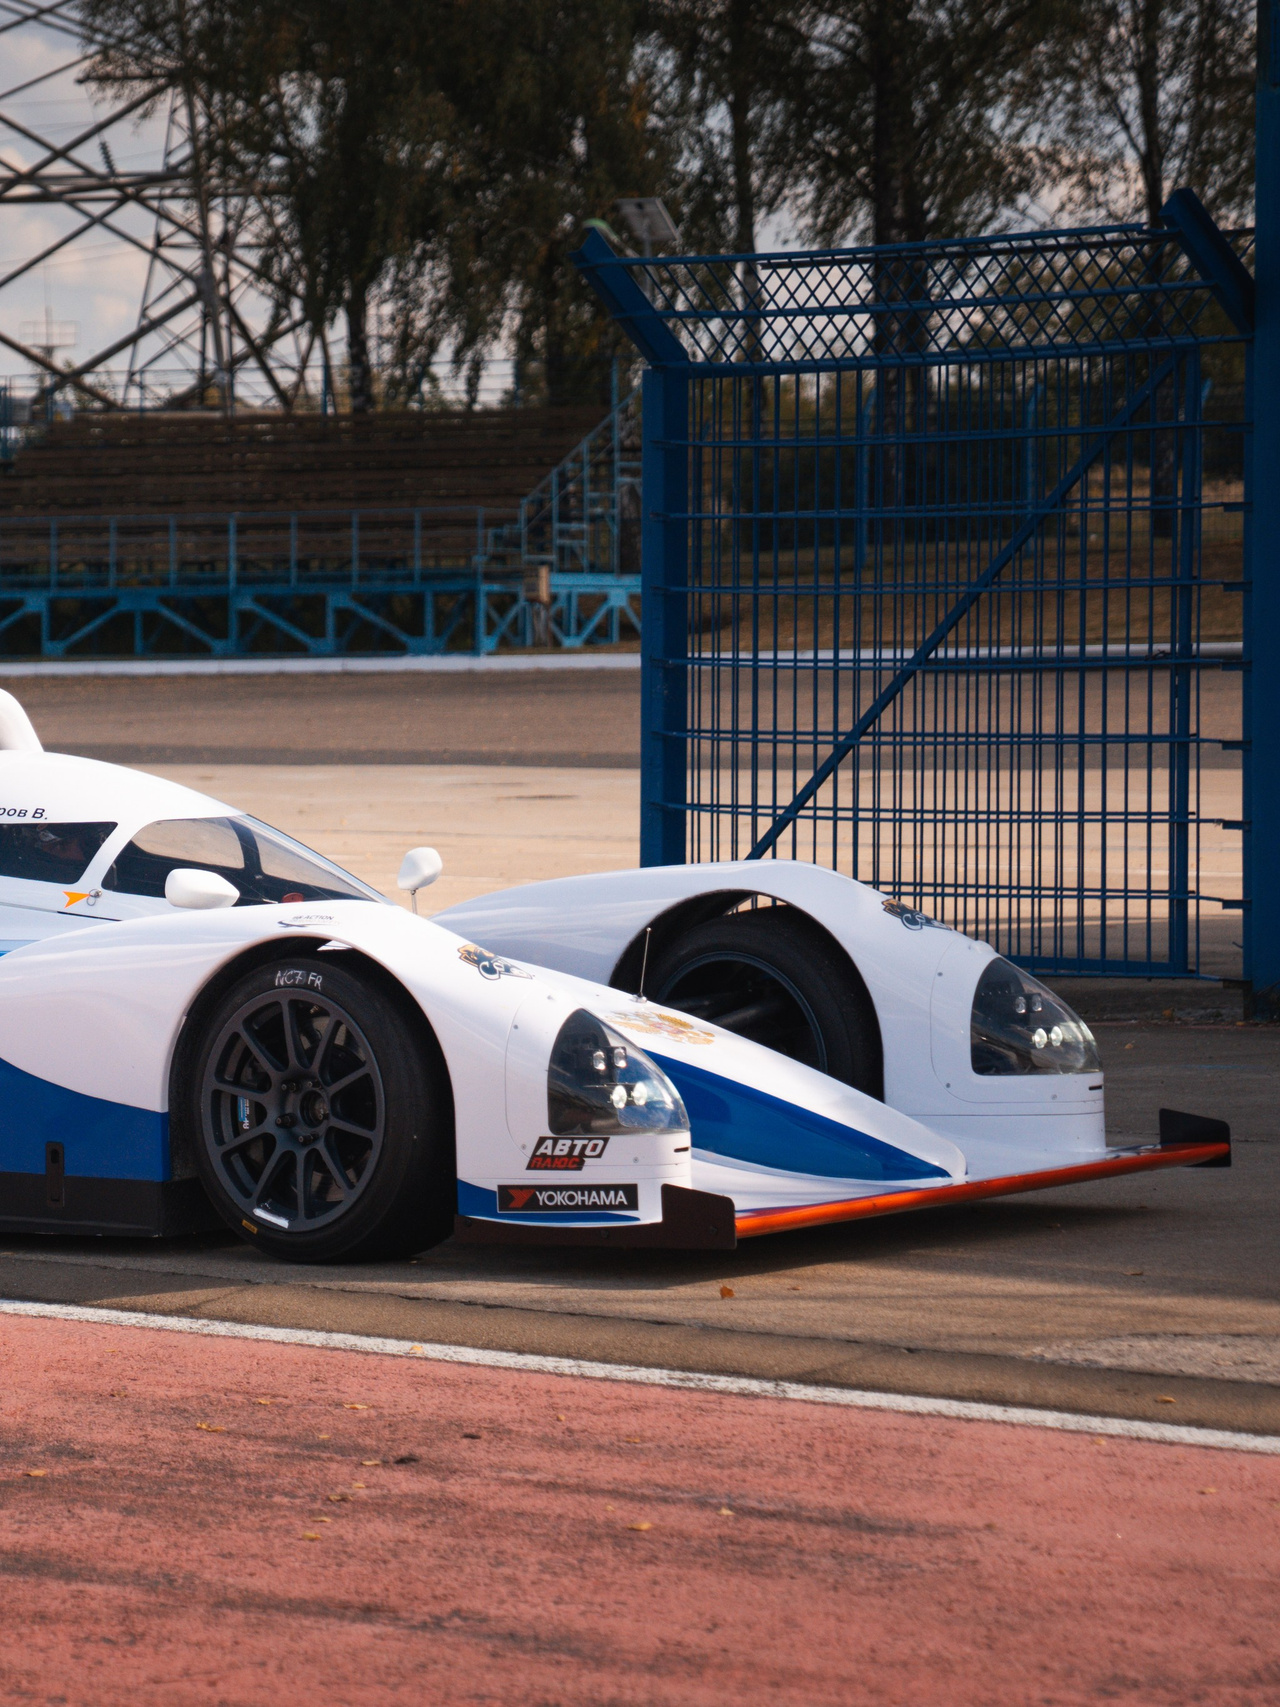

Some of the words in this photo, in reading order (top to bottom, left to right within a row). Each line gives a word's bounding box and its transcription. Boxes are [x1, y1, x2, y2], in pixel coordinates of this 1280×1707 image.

[275, 969, 303, 986] NC7
[307, 972, 323, 990] FR
[535, 1139, 605, 1156] АВТО
[530, 1157, 581, 1169] ПЛЮС
[535, 1190, 628, 1206] YOKOHAMA
